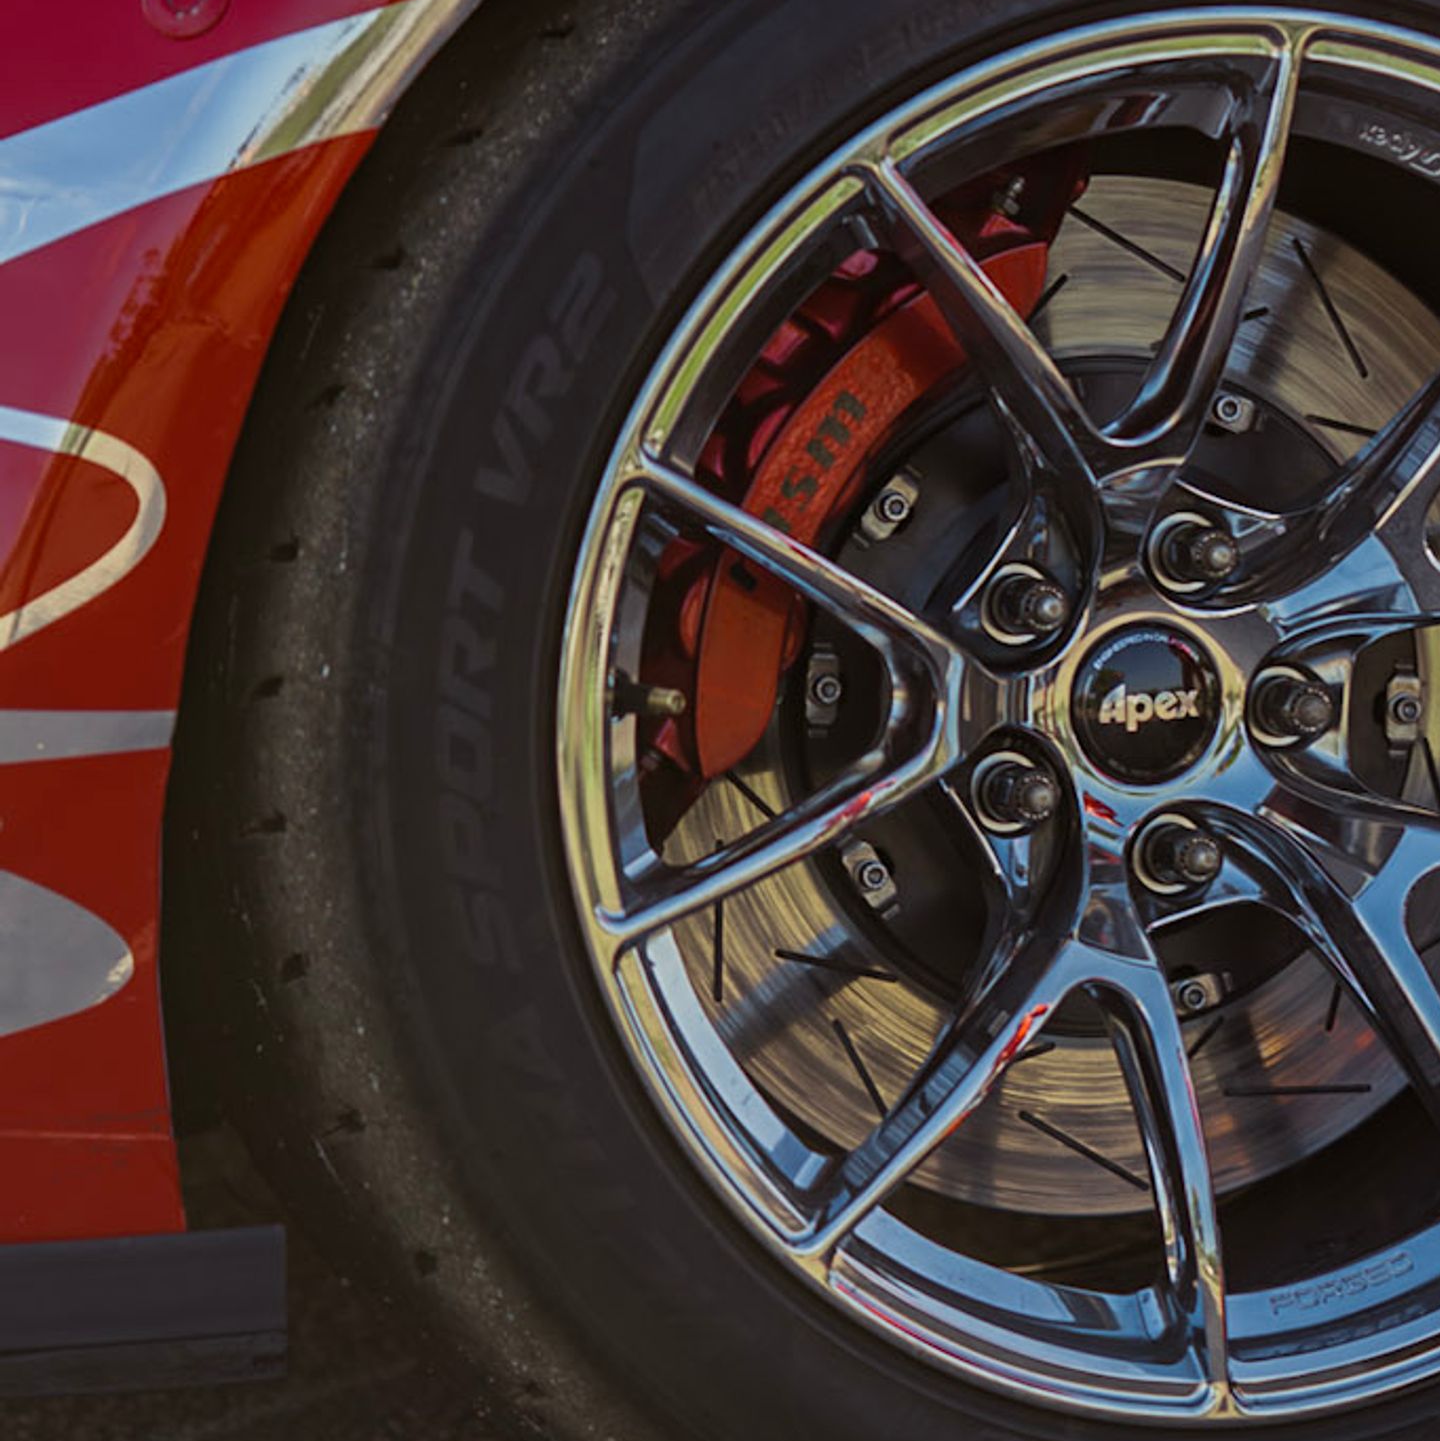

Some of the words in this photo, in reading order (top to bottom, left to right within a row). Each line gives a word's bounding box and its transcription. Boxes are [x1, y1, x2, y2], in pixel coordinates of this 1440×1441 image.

[472, 248, 617, 508] VR2
[432, 526, 524, 975] SPORT
[1099, 683, 1199, 733] Apex
